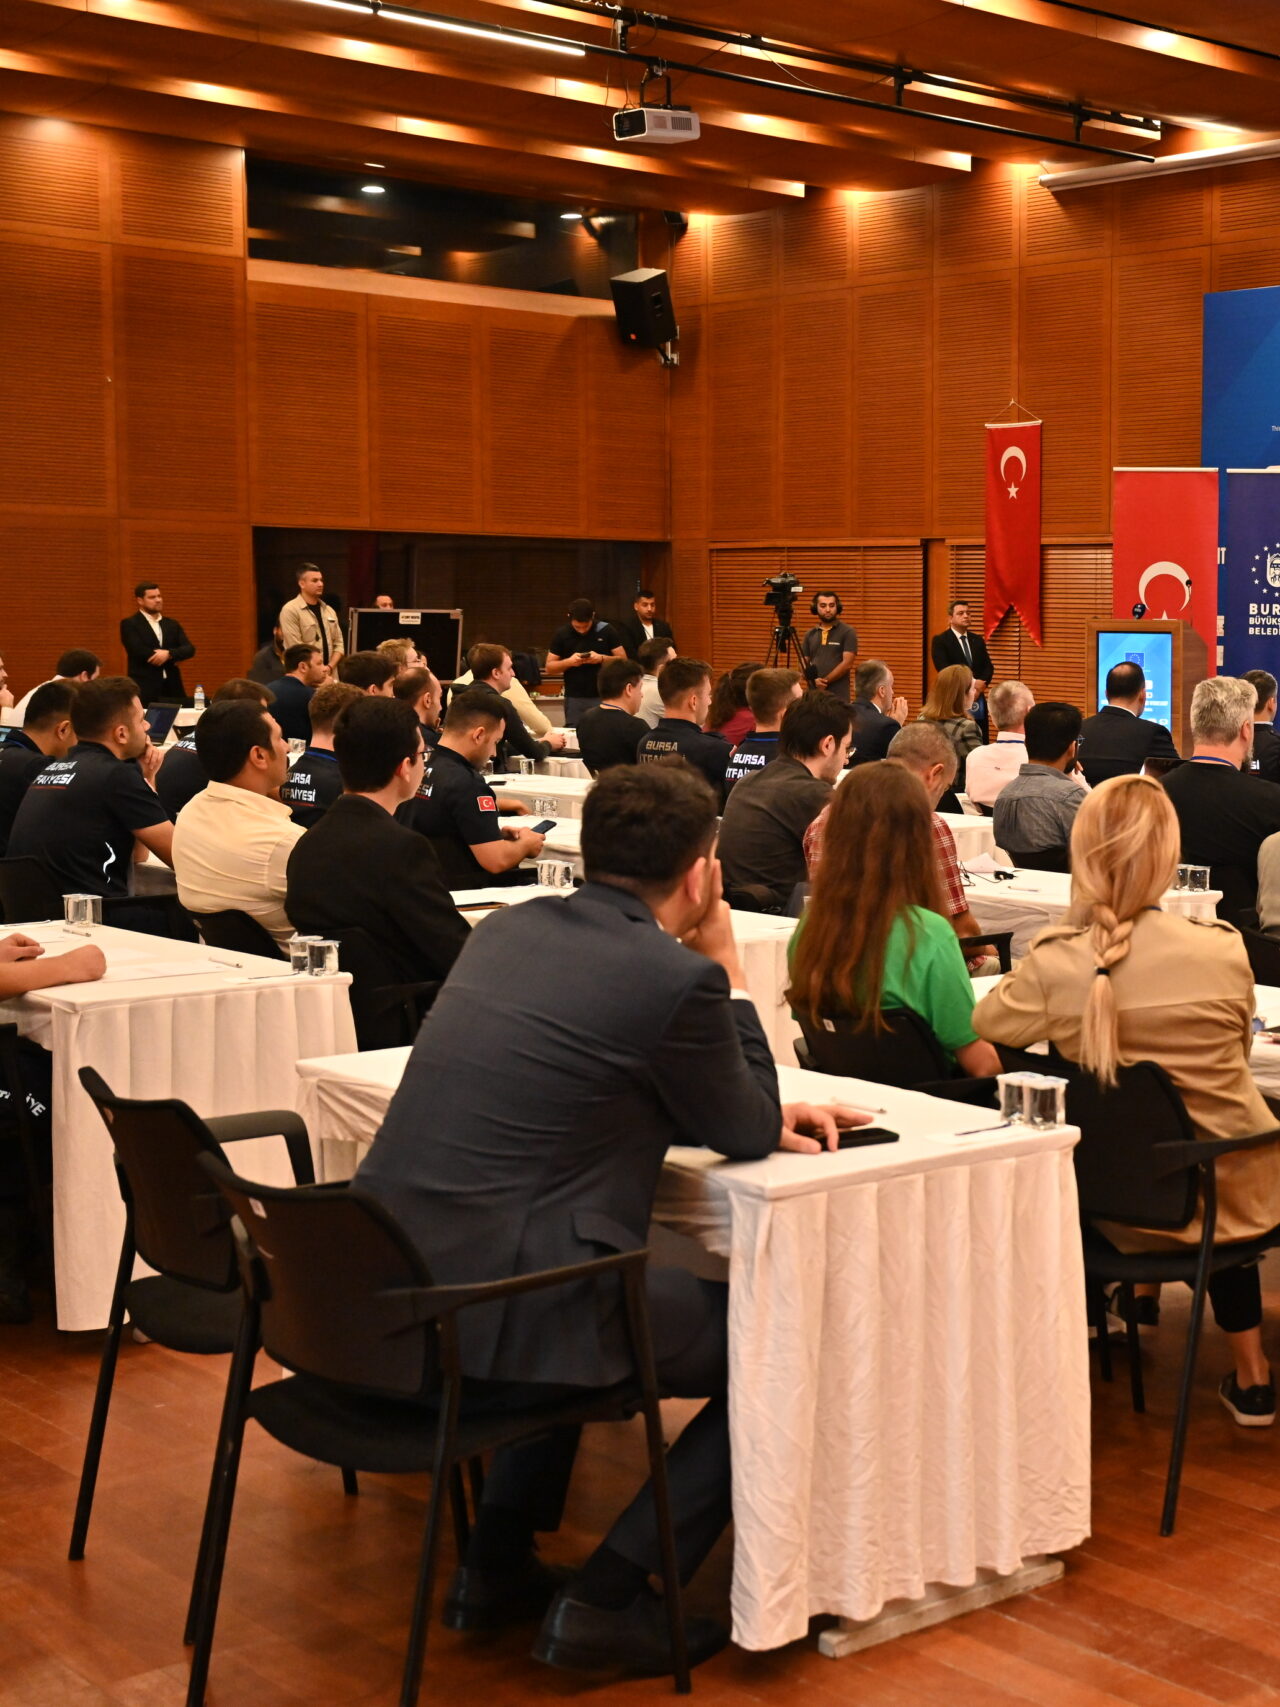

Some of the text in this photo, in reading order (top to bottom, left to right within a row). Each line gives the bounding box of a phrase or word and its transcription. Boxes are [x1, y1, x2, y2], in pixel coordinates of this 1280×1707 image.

[645, 740, 678, 752] BURSA
[732, 753, 766, 766] BURSA
[288, 772, 312, 786] URSA
